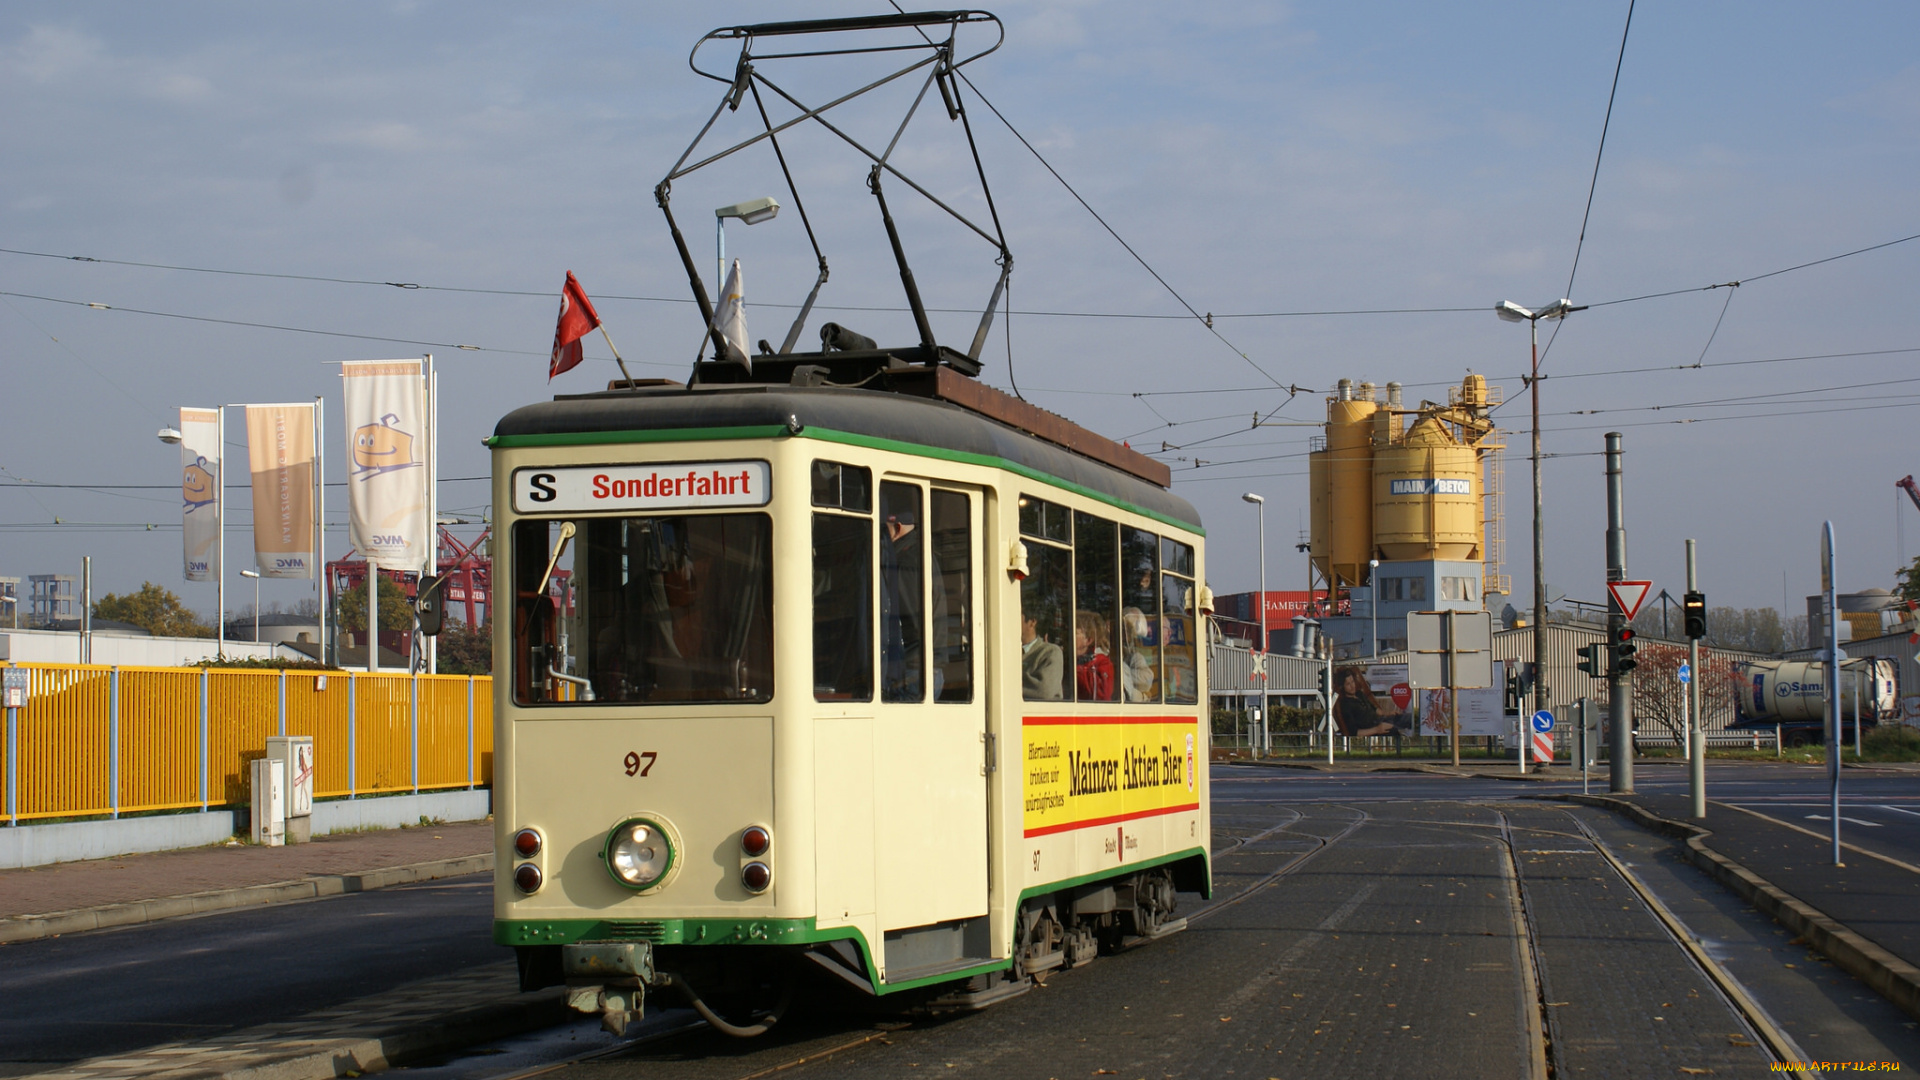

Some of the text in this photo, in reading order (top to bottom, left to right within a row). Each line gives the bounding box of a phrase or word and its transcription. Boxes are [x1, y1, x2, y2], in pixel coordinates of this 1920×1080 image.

[529, 470, 750, 502] S Sonderfahrt
[1393, 480, 1470, 493] MAIN BETON
[1028, 741, 1060, 760] Hierzulande
[623, 751, 658, 777] 97
[1068, 747, 1118, 797] Mainzer
[1122, 744, 1159, 791] Aktien
[1161, 742, 1182, 786] Bier
[1029, 765, 1060, 785] trinken wir
[1032, 850, 1041, 871] 97
